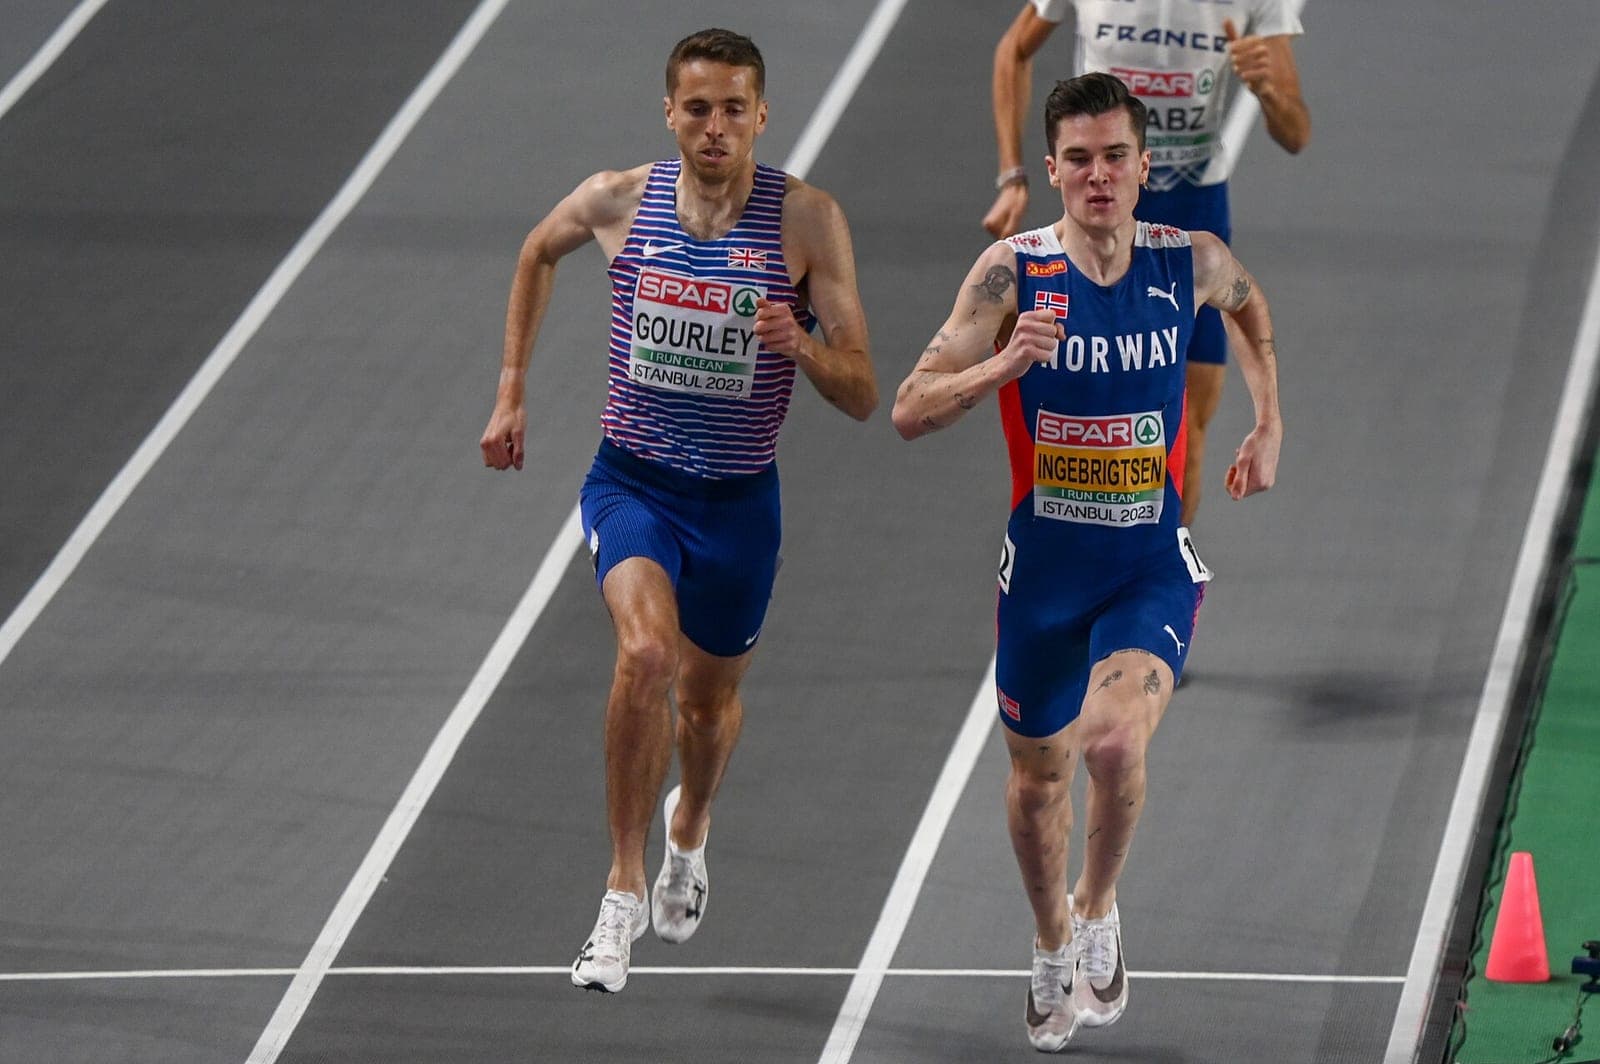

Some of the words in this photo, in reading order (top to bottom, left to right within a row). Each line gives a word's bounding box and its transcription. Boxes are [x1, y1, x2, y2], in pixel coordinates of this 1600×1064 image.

[1146, 106, 1205, 131] ABZ
[640, 276, 727, 310] SPAR
[636, 312, 755, 357] GOURLEY
[650, 351, 654, 361] I
[656, 353, 682, 366] RUN
[684, 357, 724, 372] CLEAN
[634, 363, 702, 388] ISTANBUL
[705, 376, 744, 392] 2023
[1039, 419, 1130, 444] SPAR
[1038, 453, 1162, 486] INGEBRIGTSEN
[1067, 489, 1093, 502] RUN
[1096, 493, 1135, 503] CLEAN
[1043, 501, 1118, 522] ISTANBUL
[1120, 505, 1154, 523] 2023
